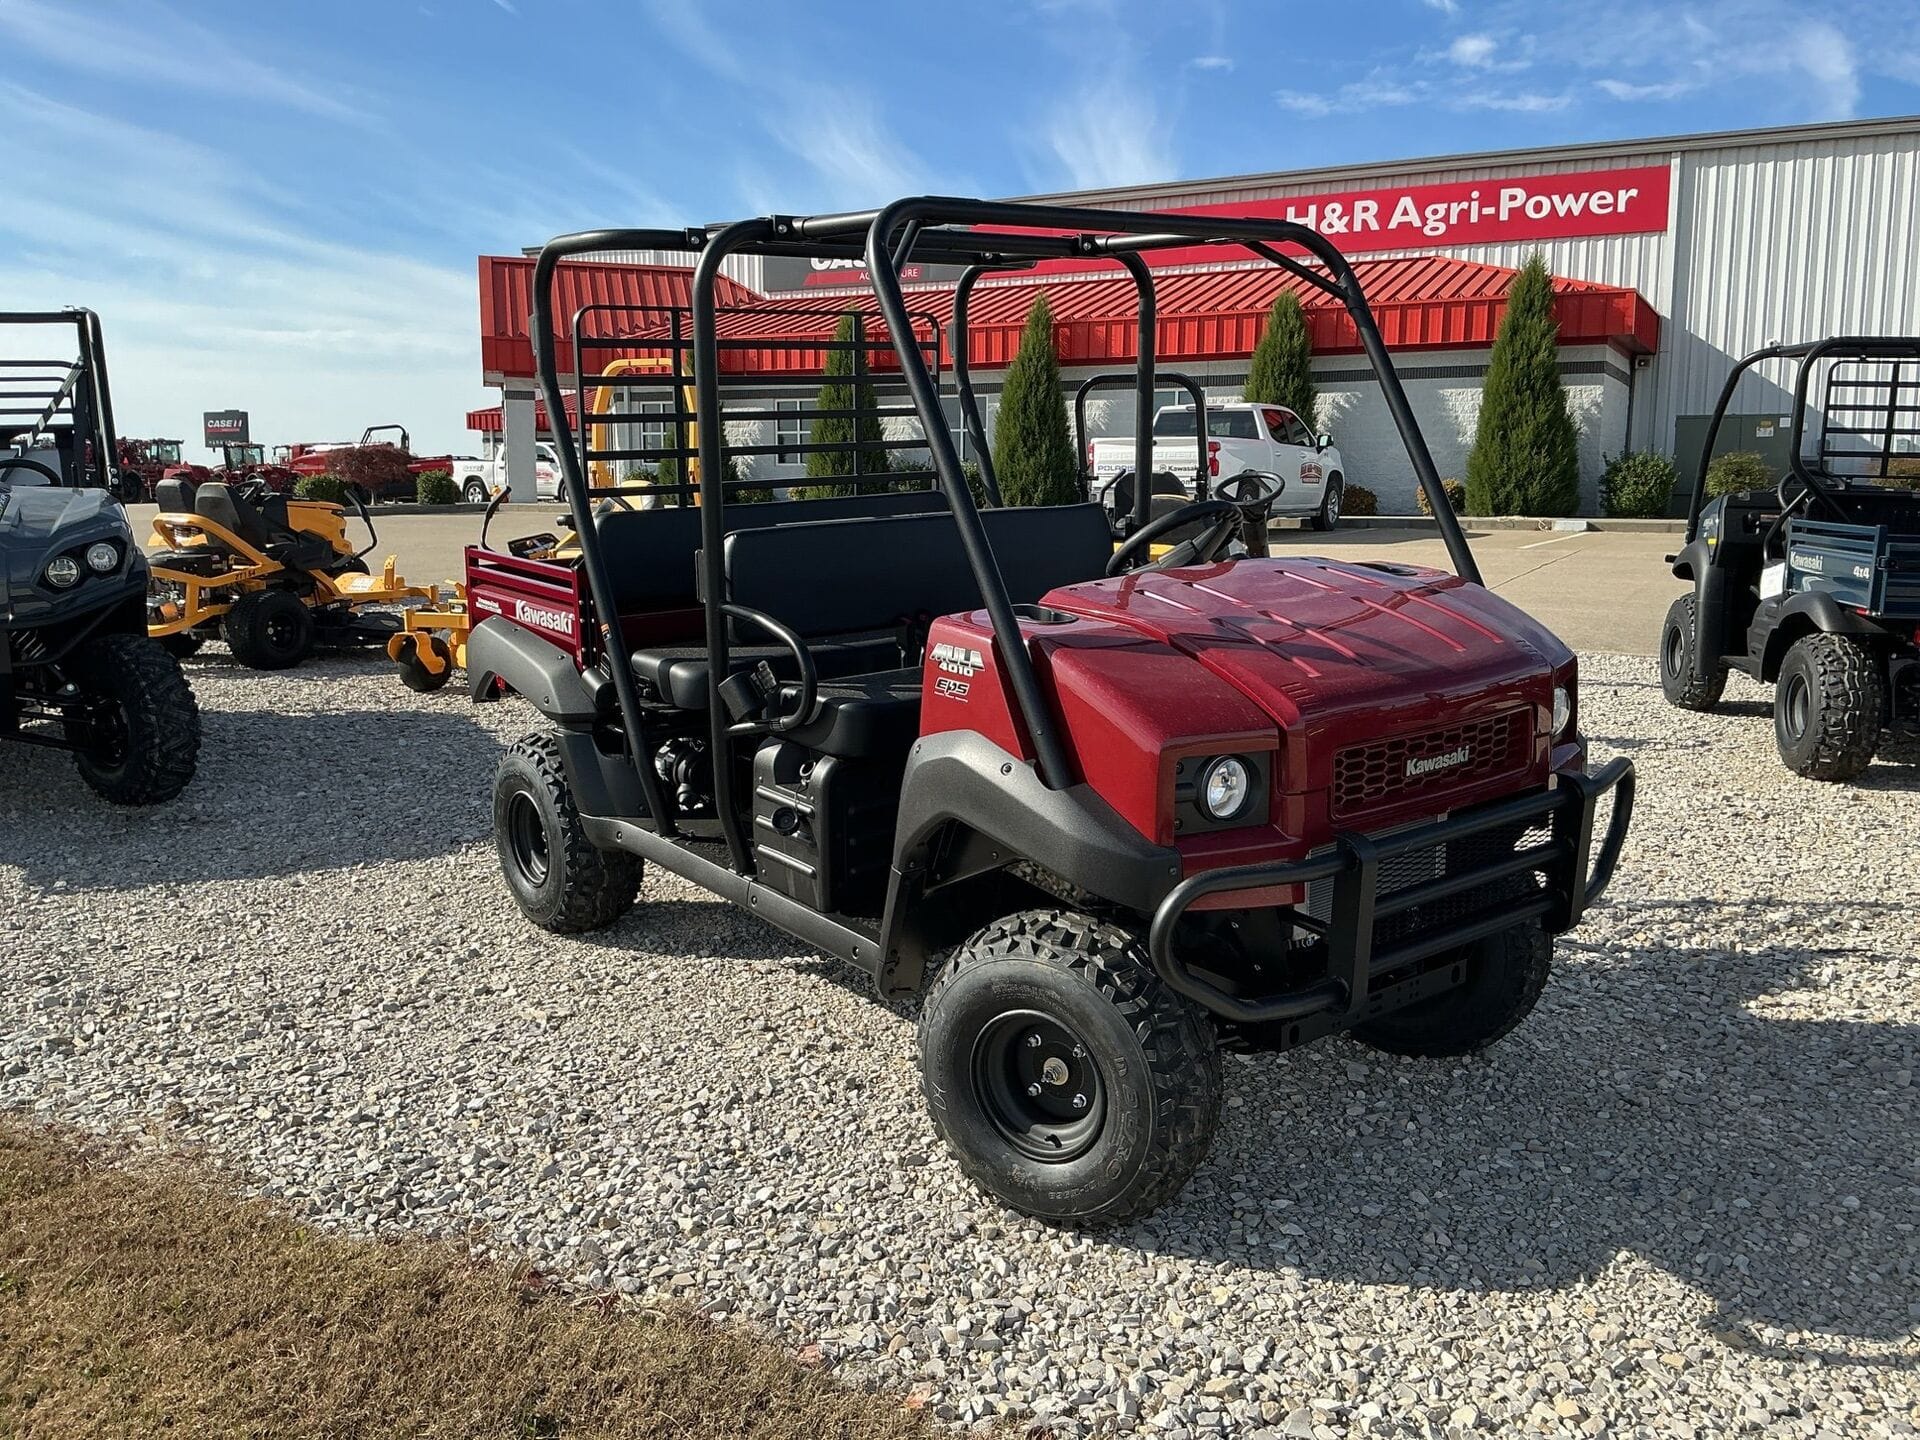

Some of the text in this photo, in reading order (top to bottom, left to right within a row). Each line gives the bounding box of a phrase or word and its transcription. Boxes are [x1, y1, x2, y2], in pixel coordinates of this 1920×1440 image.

[1285, 187, 1639, 237] H&R Agri-Power
[207, 419, 233, 428] CASE
[1790, 551, 1823, 571] Kawasaki
[1853, 565, 1870, 579] 4x4
[515, 599, 575, 635] Kawasaki
[939, 660, 974, 678] 4010
[1406, 745, 1470, 777] Kawasaki
